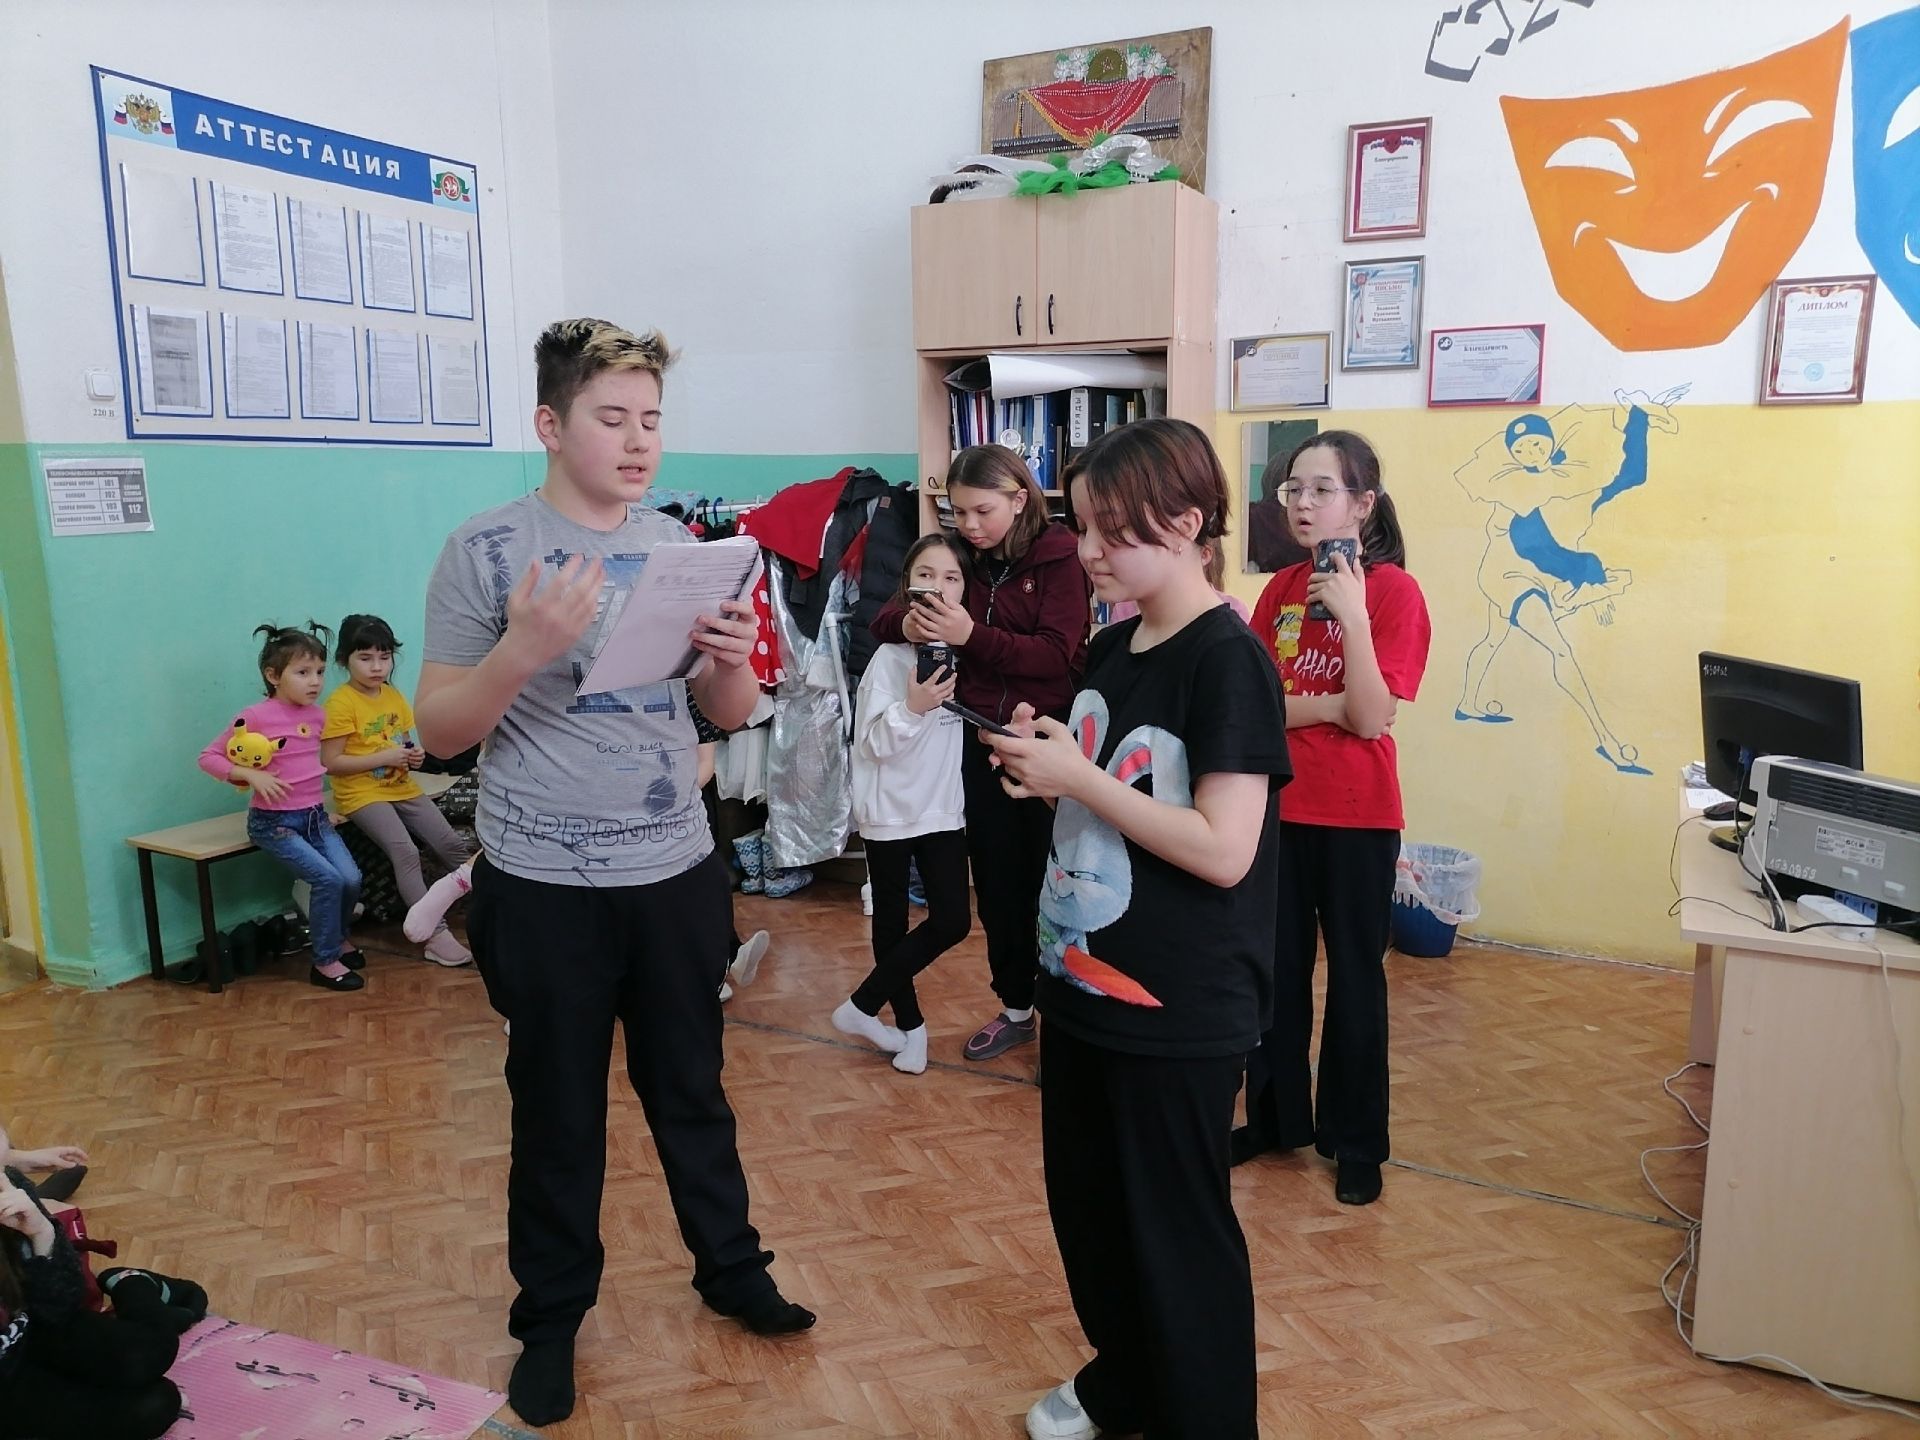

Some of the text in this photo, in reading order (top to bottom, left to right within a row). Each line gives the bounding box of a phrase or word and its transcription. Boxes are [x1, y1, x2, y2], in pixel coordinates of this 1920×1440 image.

[195, 113, 400, 180] АТТЕСТАЦИЯ
[1797, 301, 1848, 312] ДИПЛОМ
[93, 408, 107, 417] 220
[128, 504, 142, 514] 112
